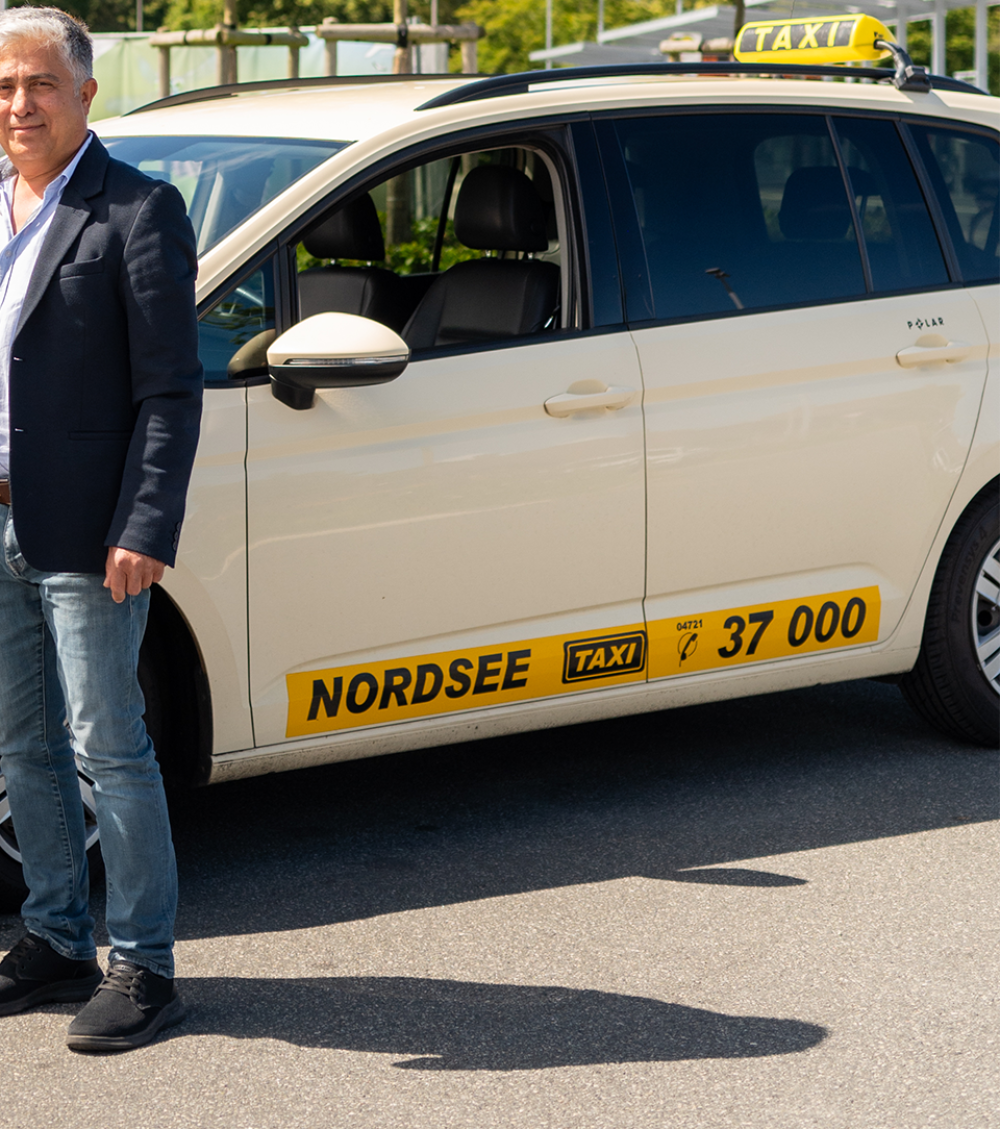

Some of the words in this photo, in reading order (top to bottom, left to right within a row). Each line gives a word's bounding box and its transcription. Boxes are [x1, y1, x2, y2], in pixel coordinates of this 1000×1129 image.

[755, 22, 841, 52] TAXI
[676, 619, 703, 632] 04721
[306, 649, 532, 721] NORDSEE
[574, 642, 638, 672] TAXI
[717, 610, 774, 659] 37
[787, 597, 867, 648] 000
